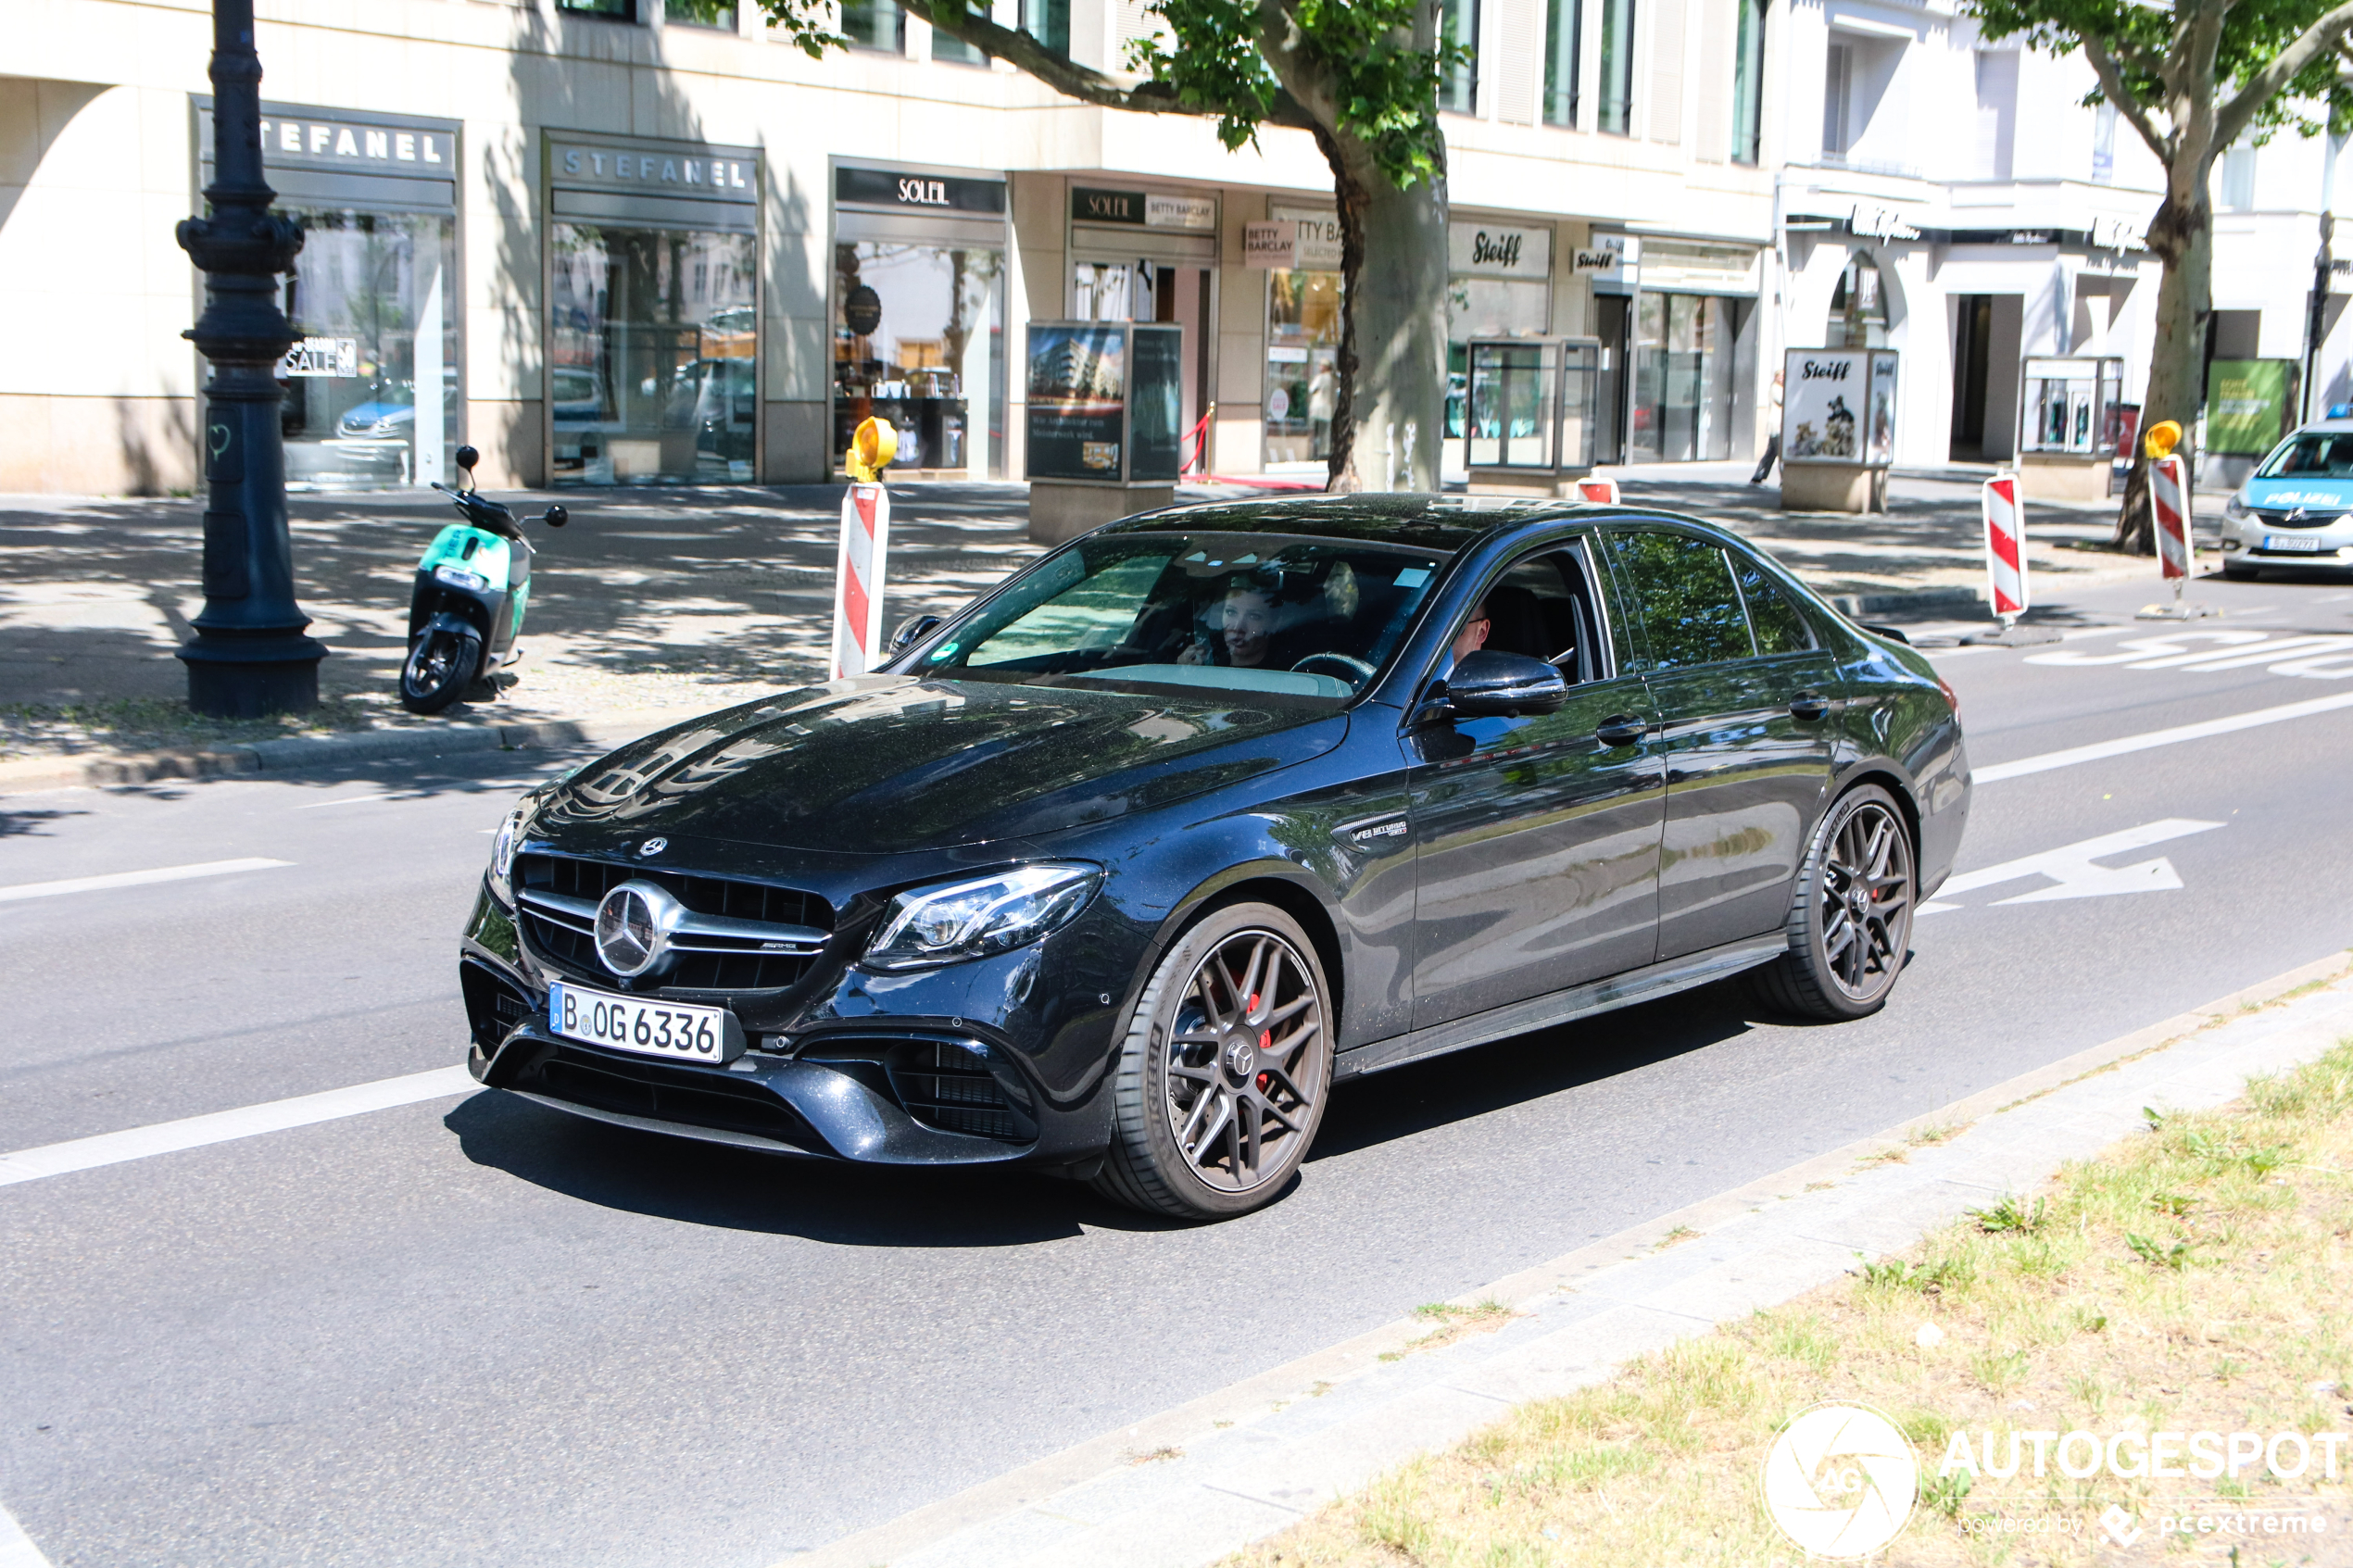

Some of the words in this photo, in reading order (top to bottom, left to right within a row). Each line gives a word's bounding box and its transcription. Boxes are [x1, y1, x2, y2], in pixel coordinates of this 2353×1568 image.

[259, 120, 441, 164] TEFANEL
[564, 148, 746, 189] STEFANEL
[898, 178, 950, 205] SOLEIL
[1151, 201, 1175, 214] BETTY
[1176, 204, 1211, 218] BARCLAY
[1248, 228, 1278, 240] BETTY
[1248, 241, 1293, 252] BARCLAY
[1473, 231, 1522, 268] Steiff
[1577, 251, 1613, 270] Steiff
[285, 349, 336, 371] SALE
[1802, 359, 1852, 383] Steiff
[2263, 492, 2342, 506] POLIZEI
[442, 529, 463, 558] TIER
[1352, 829, 1373, 842] V8
[553, 1013, 560, 1024] D
[564, 993, 578, 1030] B
